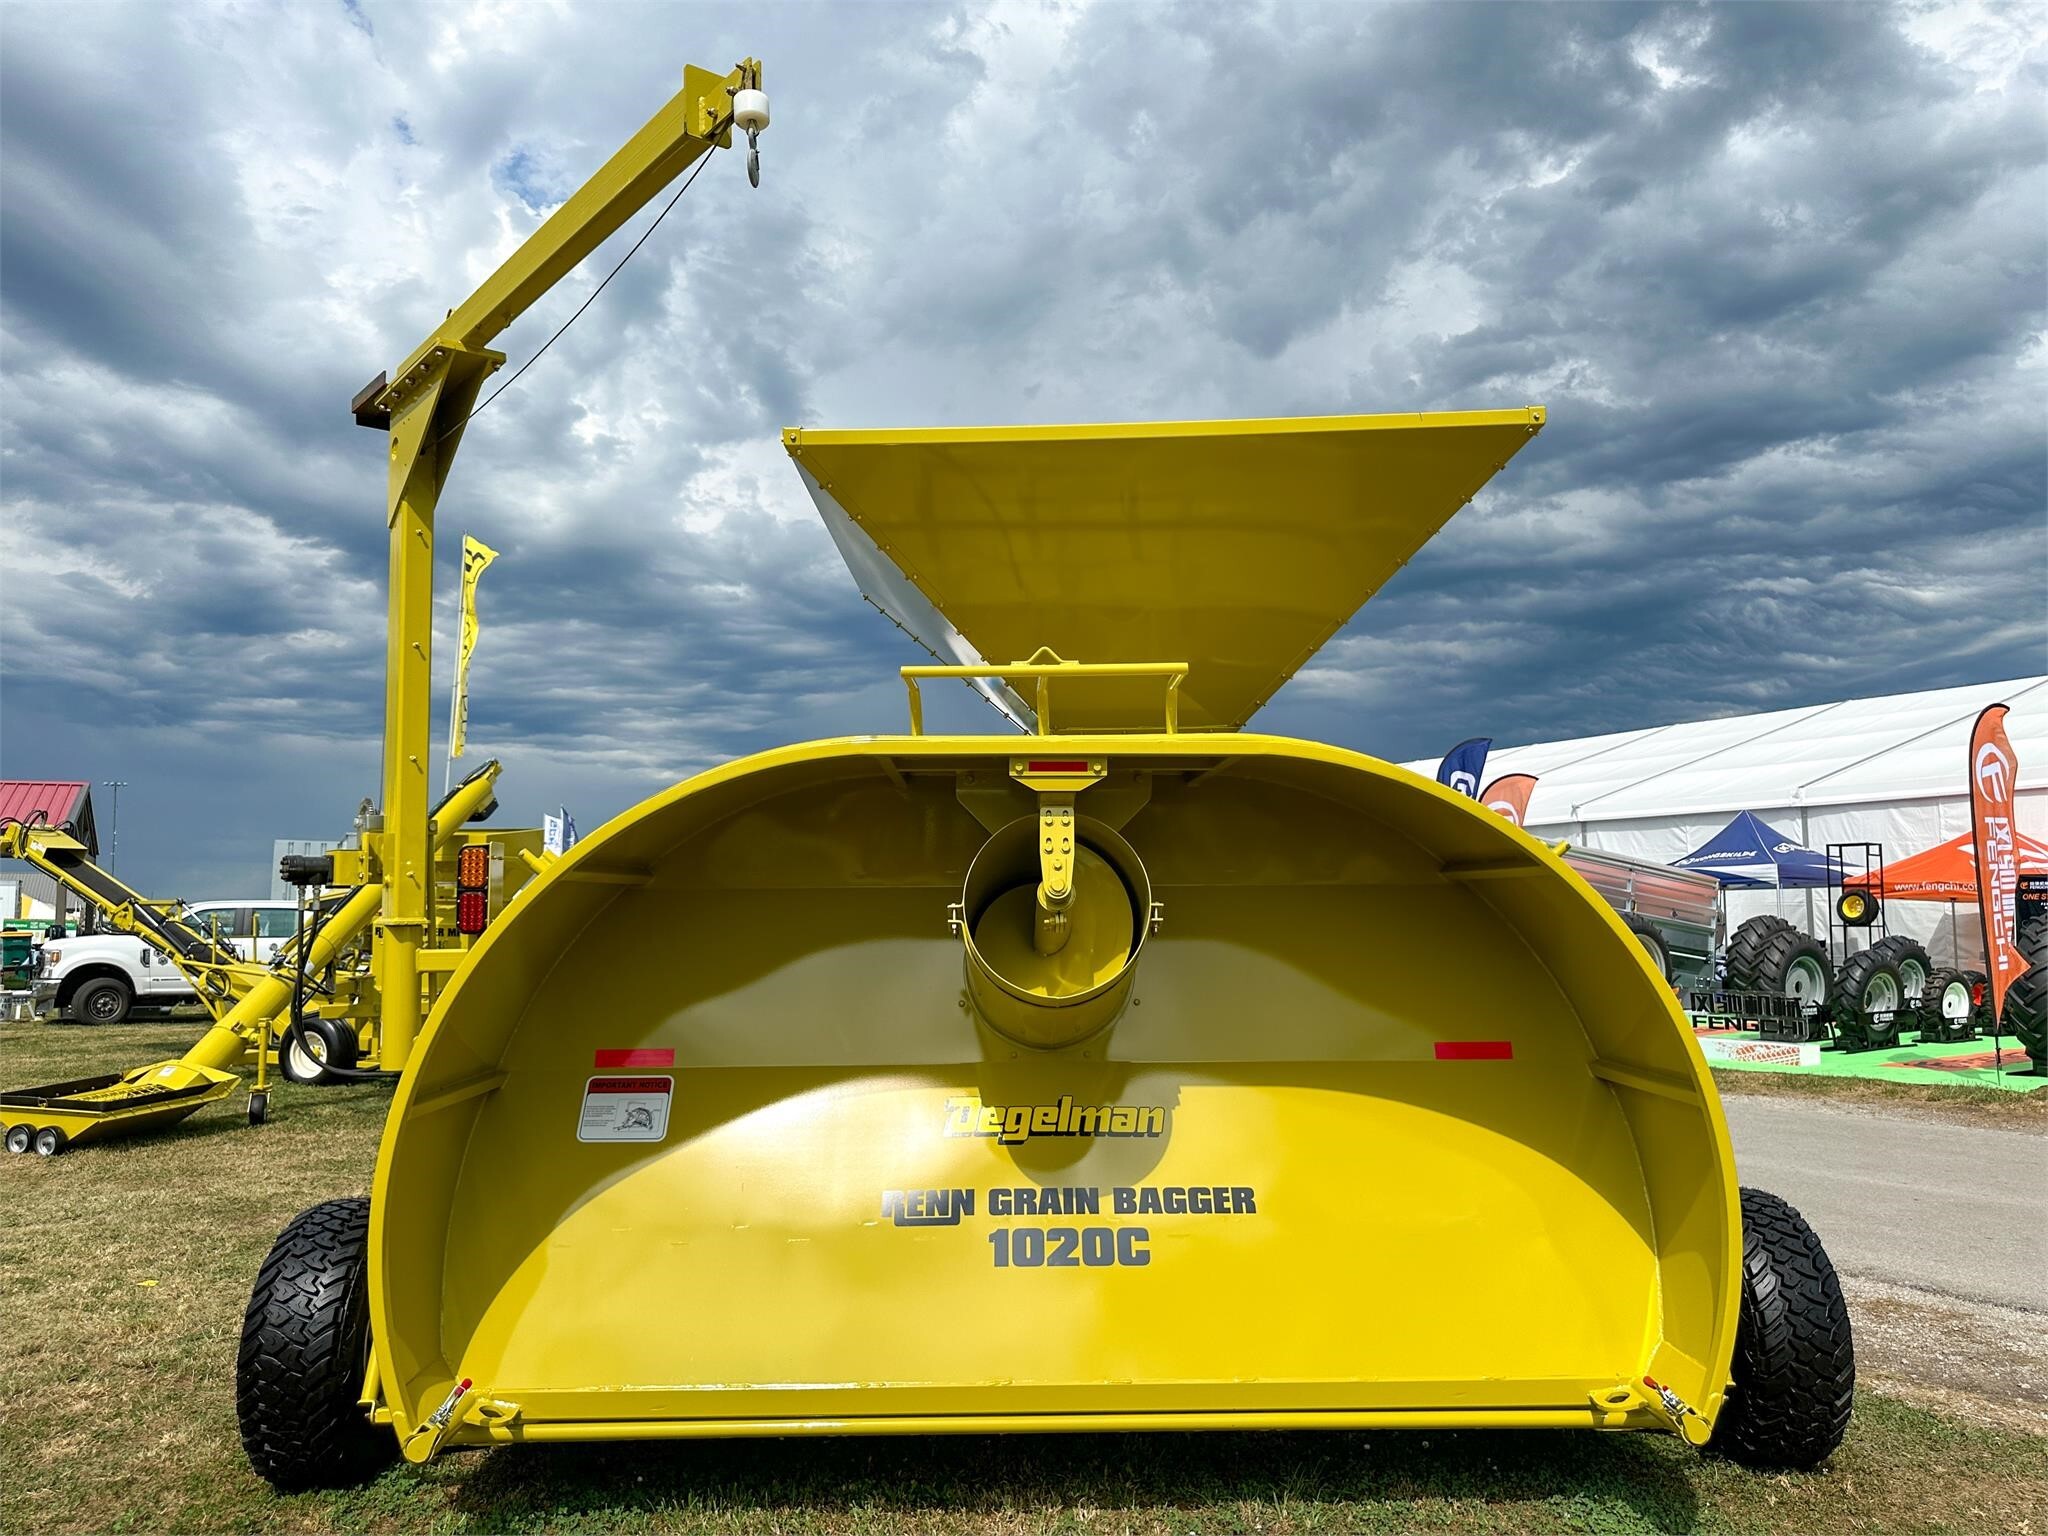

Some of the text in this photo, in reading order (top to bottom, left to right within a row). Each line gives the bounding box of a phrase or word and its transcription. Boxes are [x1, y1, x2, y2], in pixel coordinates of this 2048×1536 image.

[1984, 816, 2008, 971] FENGCHI
[1692, 1014, 1808, 1040] FENGCHI
[592, 1081, 667, 1090] IMPORTANT NOTICE
[943, 1095, 1168, 1146] Degelman
[880, 1186, 1258, 1227] RENN GRAIN BAGGER
[988, 1226, 1151, 1268] 1020C
